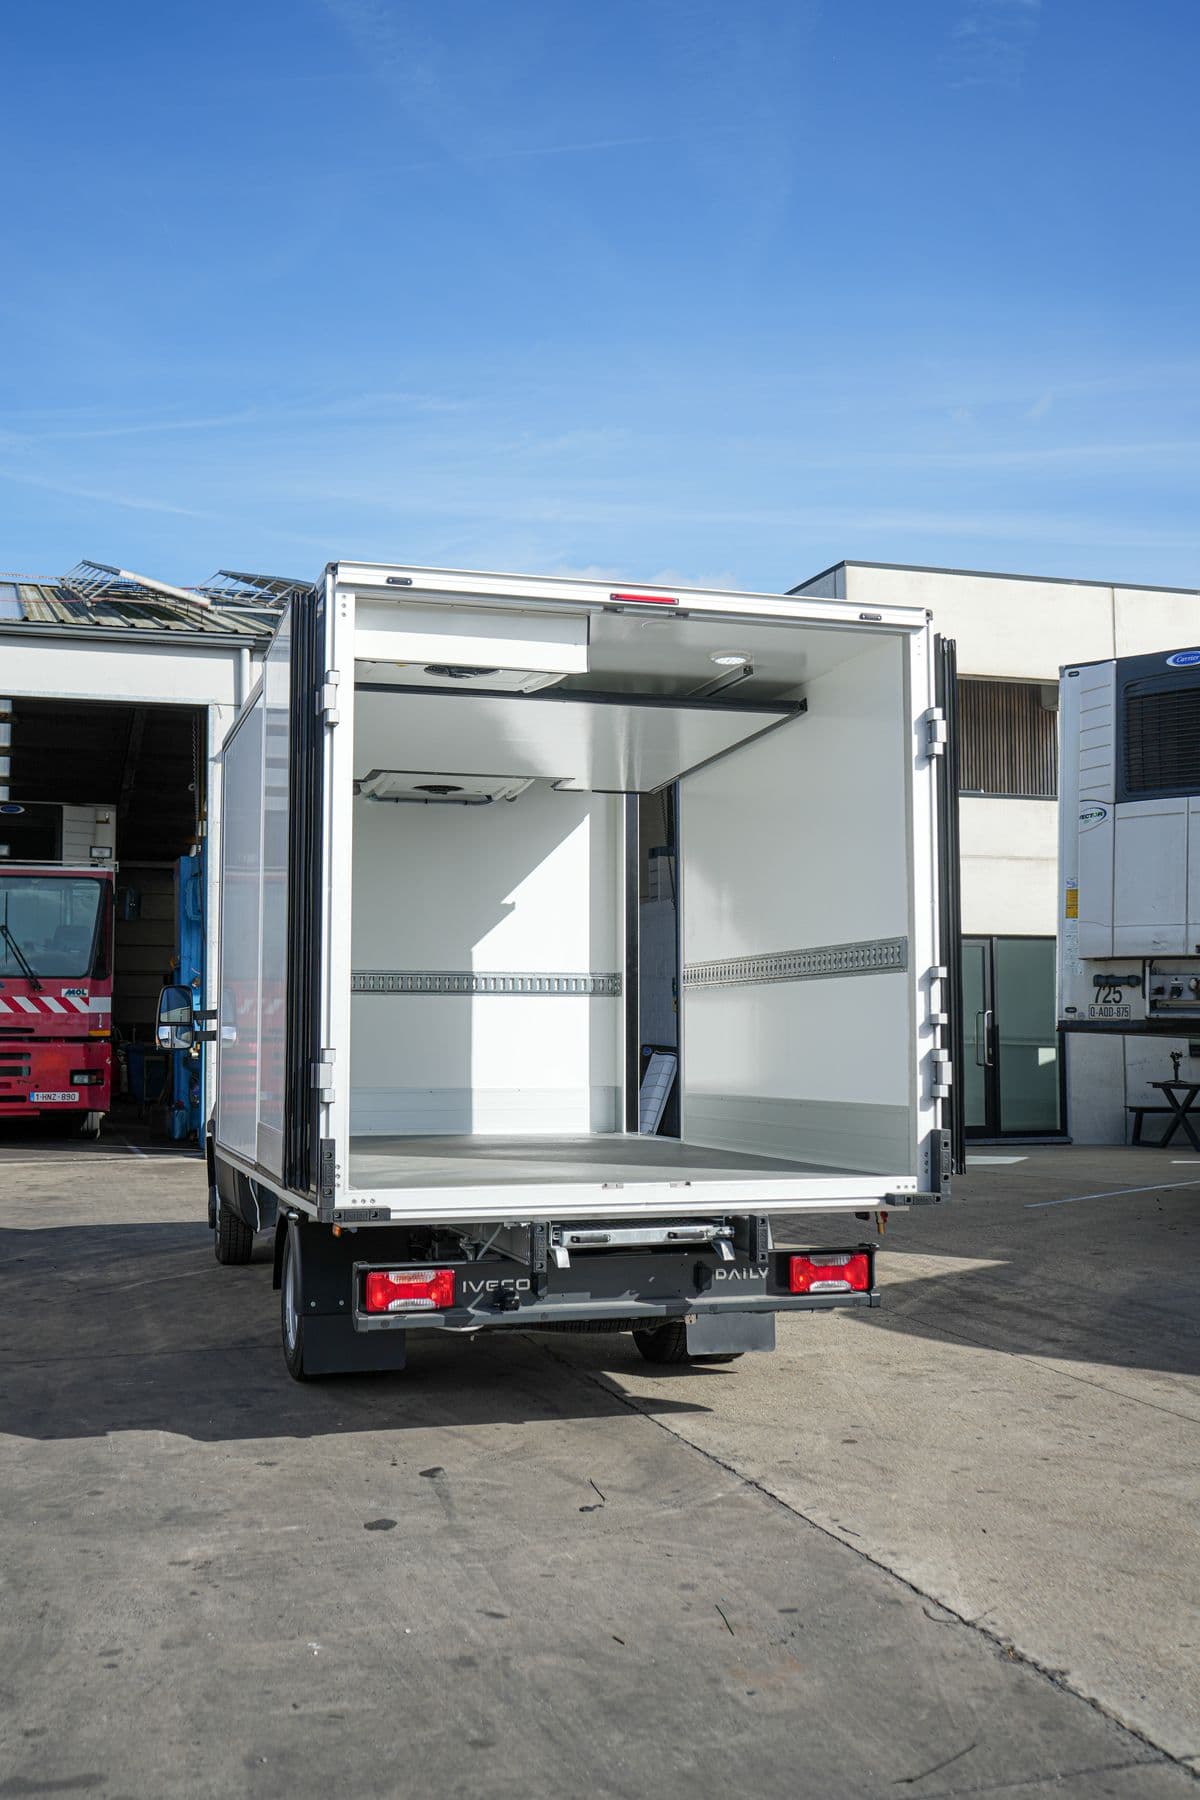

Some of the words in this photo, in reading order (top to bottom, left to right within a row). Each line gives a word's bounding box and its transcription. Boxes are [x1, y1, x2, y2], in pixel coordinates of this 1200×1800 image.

[1176, 654, 1200, 664] Carrier
[64, 988, 87, 996] MOL
[1095, 985, 1123, 1004] 725
[715, 1267, 769, 1280] DAILY
[462, 1278, 531, 1293] IVECO
